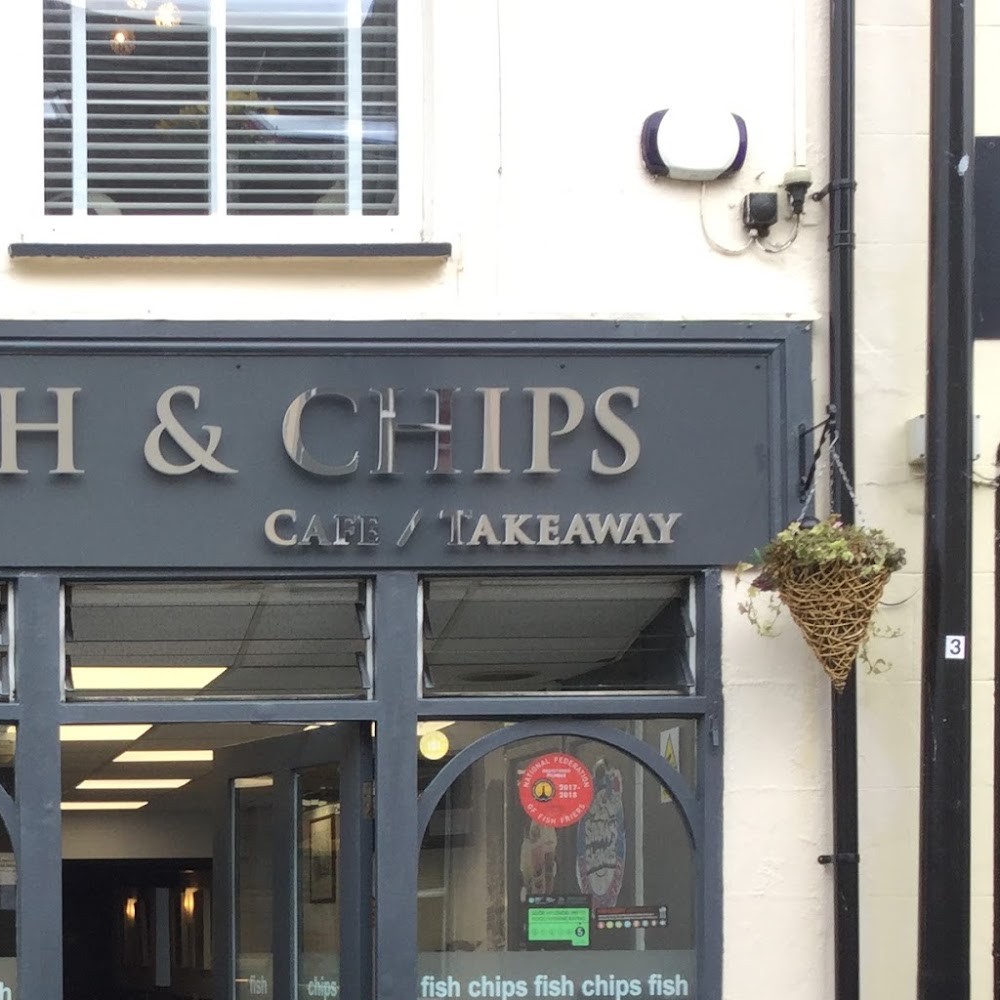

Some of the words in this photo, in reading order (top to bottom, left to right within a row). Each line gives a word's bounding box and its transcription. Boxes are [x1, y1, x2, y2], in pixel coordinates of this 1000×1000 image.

[143, 386, 239, 477] &
[281, 385, 642, 477] CHIPS
[264, 509, 381, 547] CAFE
[439, 509, 683, 547] TAKEAWAY
[950, 638, 961, 655] 3
[523, 758, 550, 788] NATIONAL
[553, 756, 590, 788] FEDERATION
[527, 803, 537, 813] OF
[537, 813, 556, 824] FISH
[560, 803, 586, 824] FRIERS
[249, 975, 268, 994] fish
[308, 976, 338, 1000] chips
[421, 975, 461, 998] fish
[534, 974, 574, 997] fish
[582, 974, 642, 1000] chips
[648, 974, 689, 997] fish
